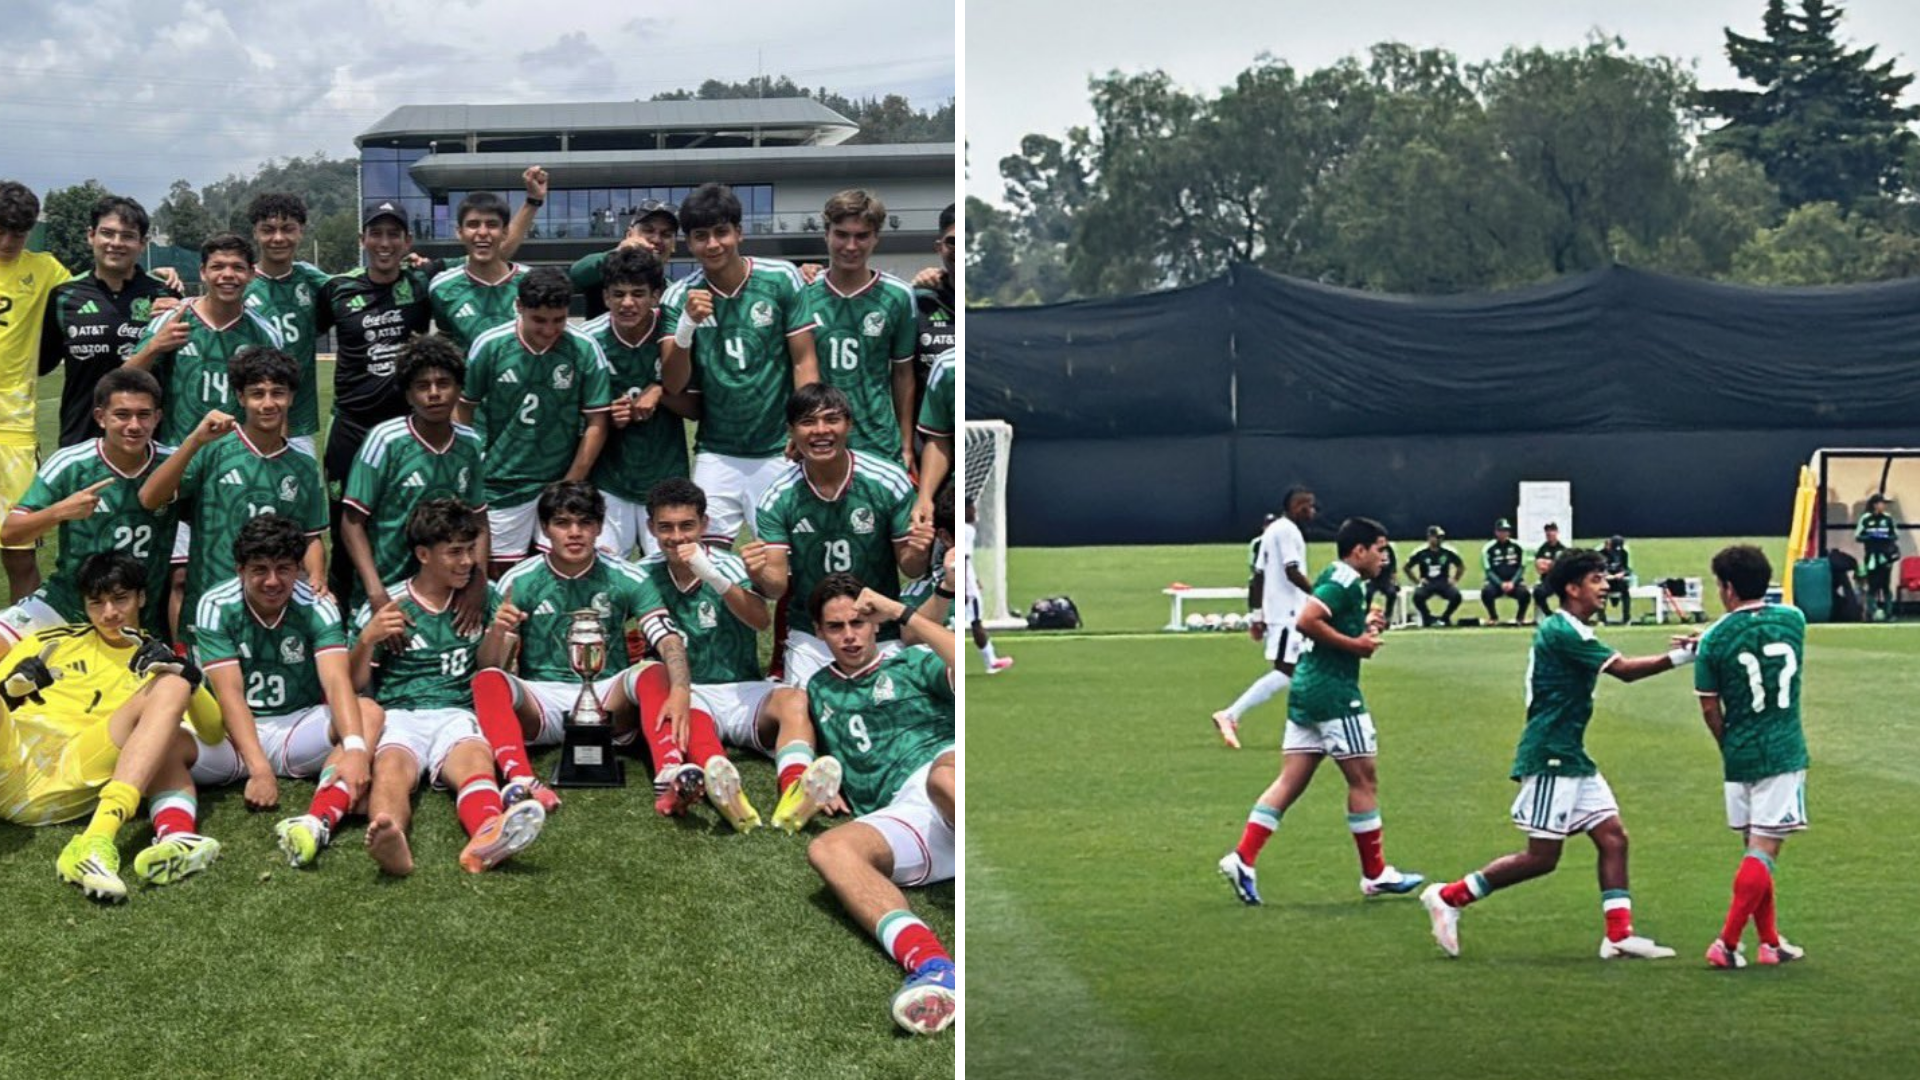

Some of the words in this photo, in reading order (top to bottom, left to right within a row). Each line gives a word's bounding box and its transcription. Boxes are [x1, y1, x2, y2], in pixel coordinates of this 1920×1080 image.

[79, 324, 109, 336] AT&T
[378, 325, 405, 338] AT&T
[932, 334, 955, 345] AT&
[69, 344, 110, 355] amazon
[724, 336, 747, 370] 4
[828, 336, 859, 370] 16
[202, 370, 229, 404] 14
[519, 392, 540, 425] 2
[114, 524, 152, 558] 22
[824, 539, 852, 573] 19
[440, 647, 468, 677] 10
[1737, 641, 1798, 713] 17
[84, 689, 103, 714] 1
[246, 670, 286, 708] 23
[848, 713, 873, 753] 9
